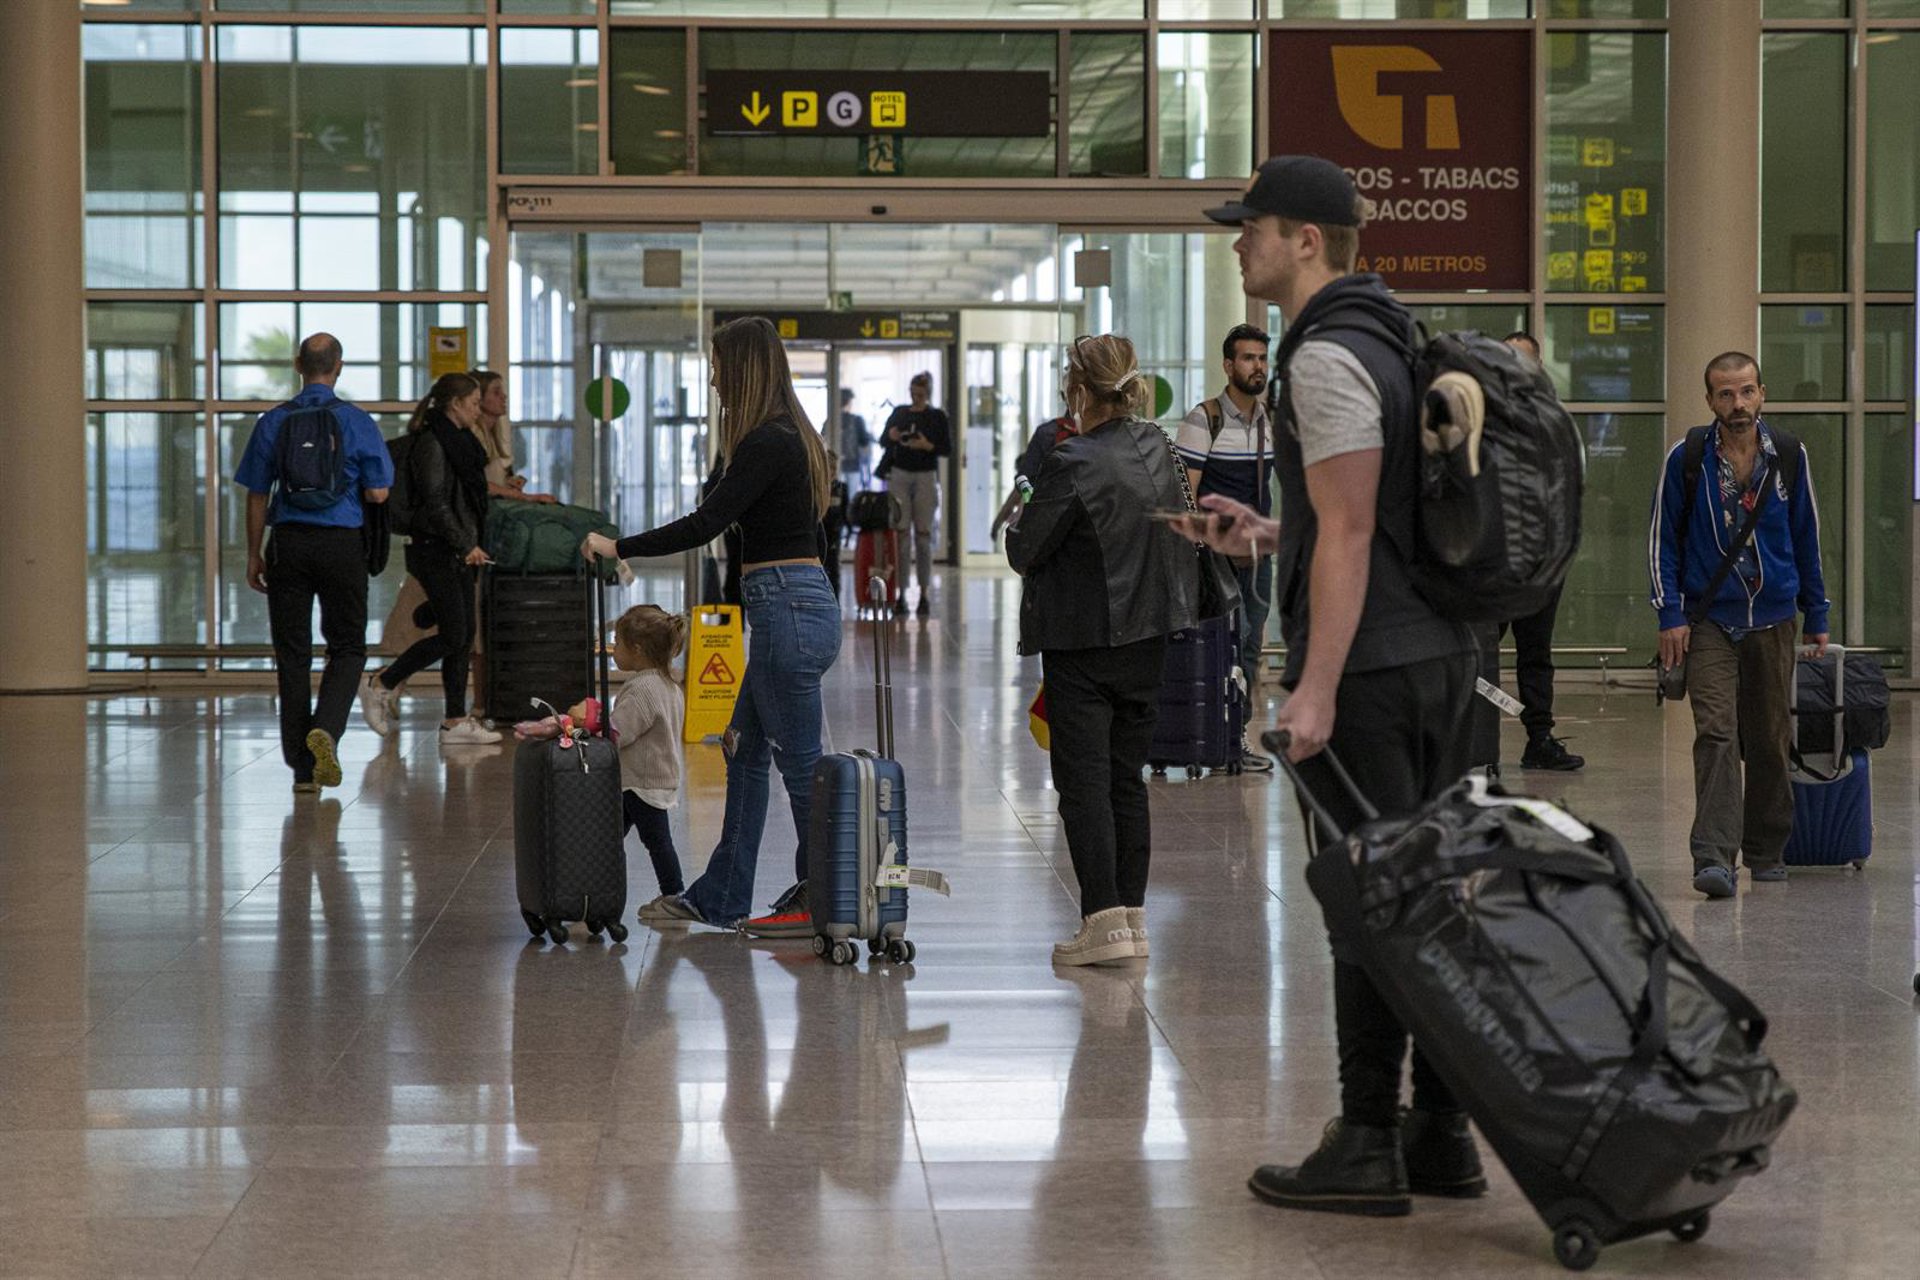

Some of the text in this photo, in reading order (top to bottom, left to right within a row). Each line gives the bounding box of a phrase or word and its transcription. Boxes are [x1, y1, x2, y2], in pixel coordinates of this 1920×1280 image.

[792, 98, 853, 121] P G
[873, 95, 903, 103] HOTEL
[1418, 167, 1520, 190] TABACS
[1364, 199, 1468, 221] BACCOS
[1374, 256, 1397, 272] 20
[1403, 256, 1487, 272] METROS
